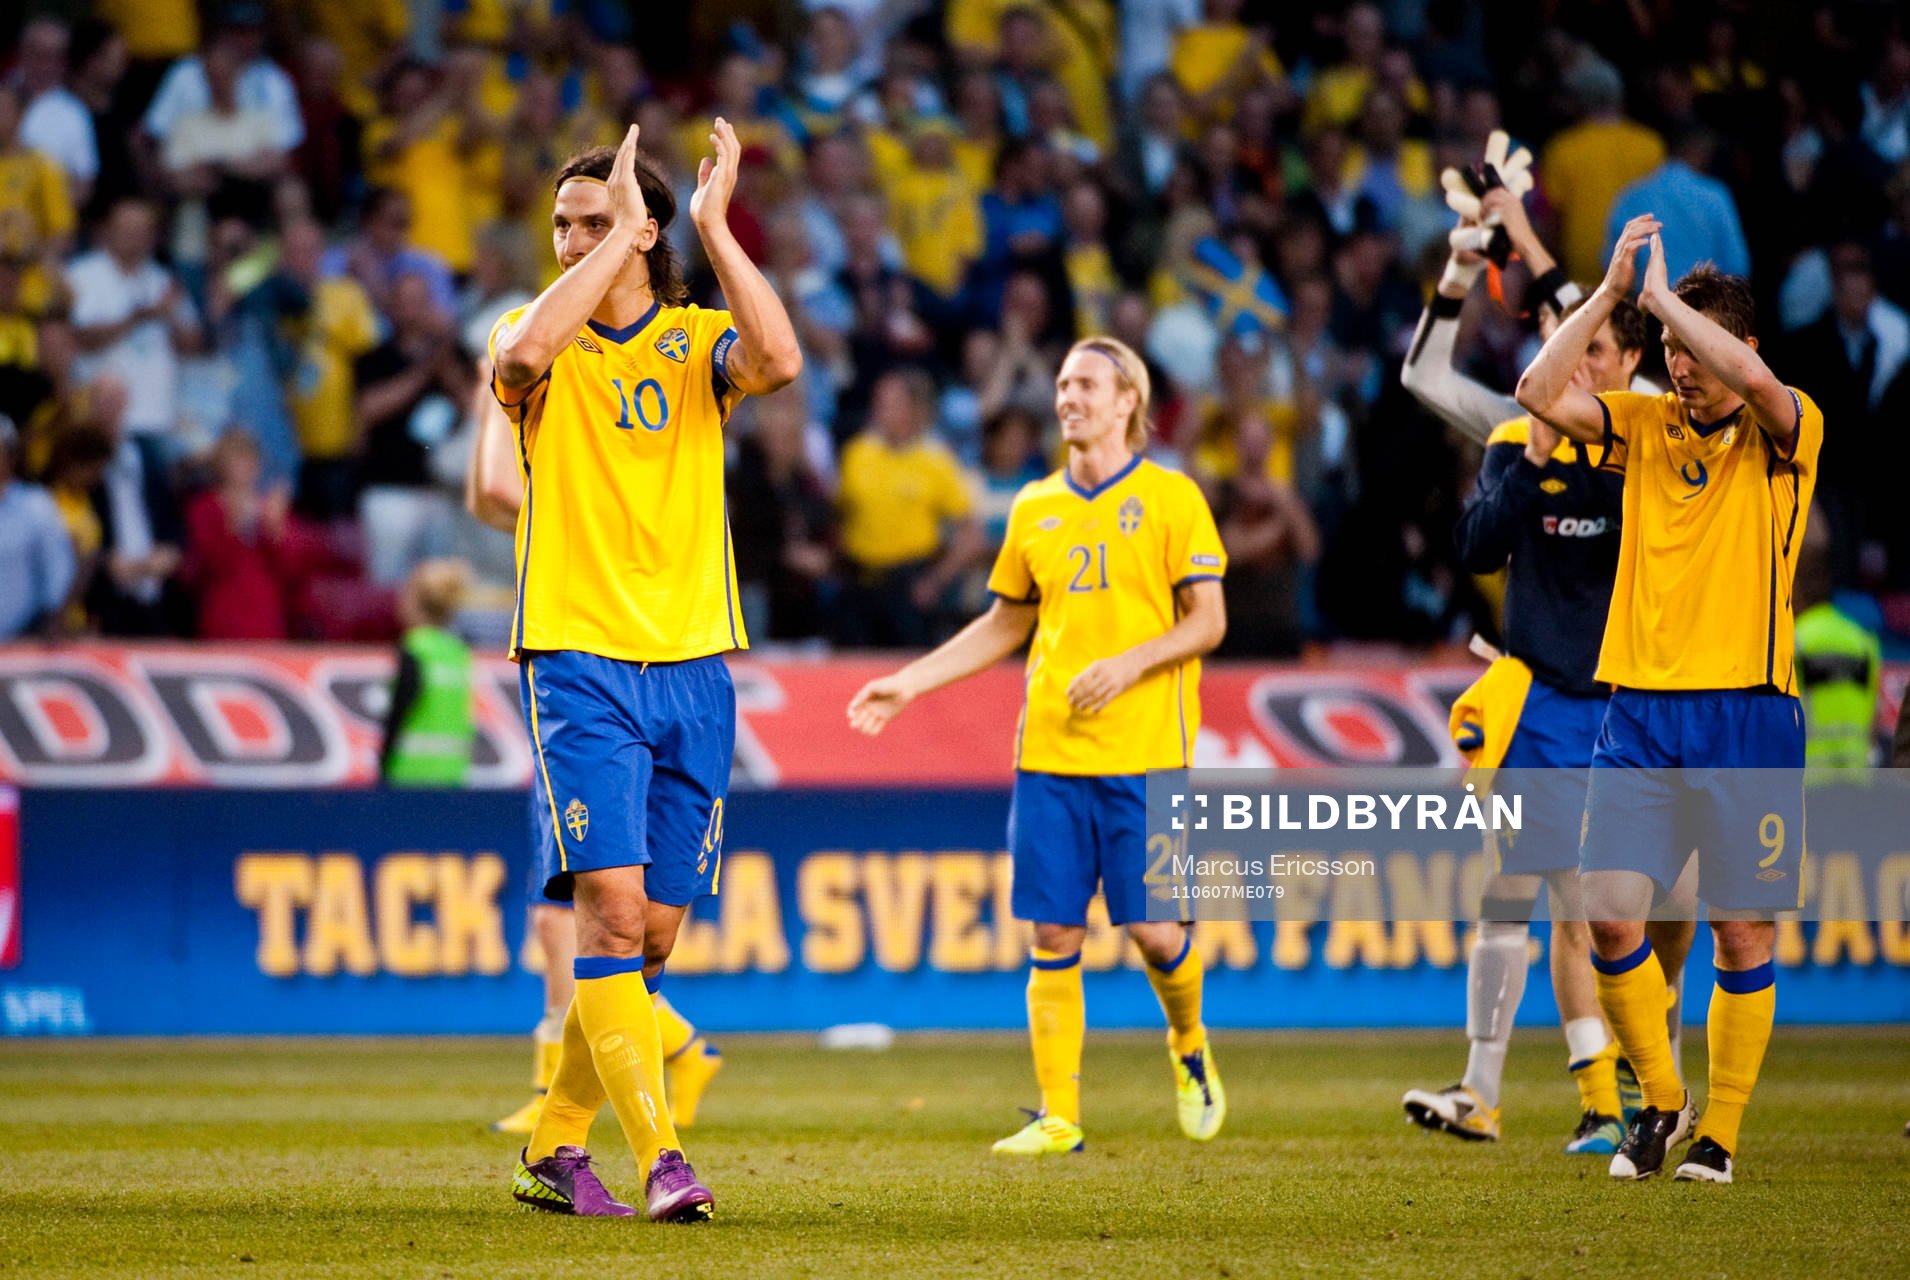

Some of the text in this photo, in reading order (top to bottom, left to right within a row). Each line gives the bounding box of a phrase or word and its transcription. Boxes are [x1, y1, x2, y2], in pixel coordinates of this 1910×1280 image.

[611, 377, 669, 432] 10
[1681, 458, 1708, 500] 9
[1067, 542, 1110, 593] 21
[1757, 813, 1786, 868] 9
[235, 852, 510, 976] TACK
